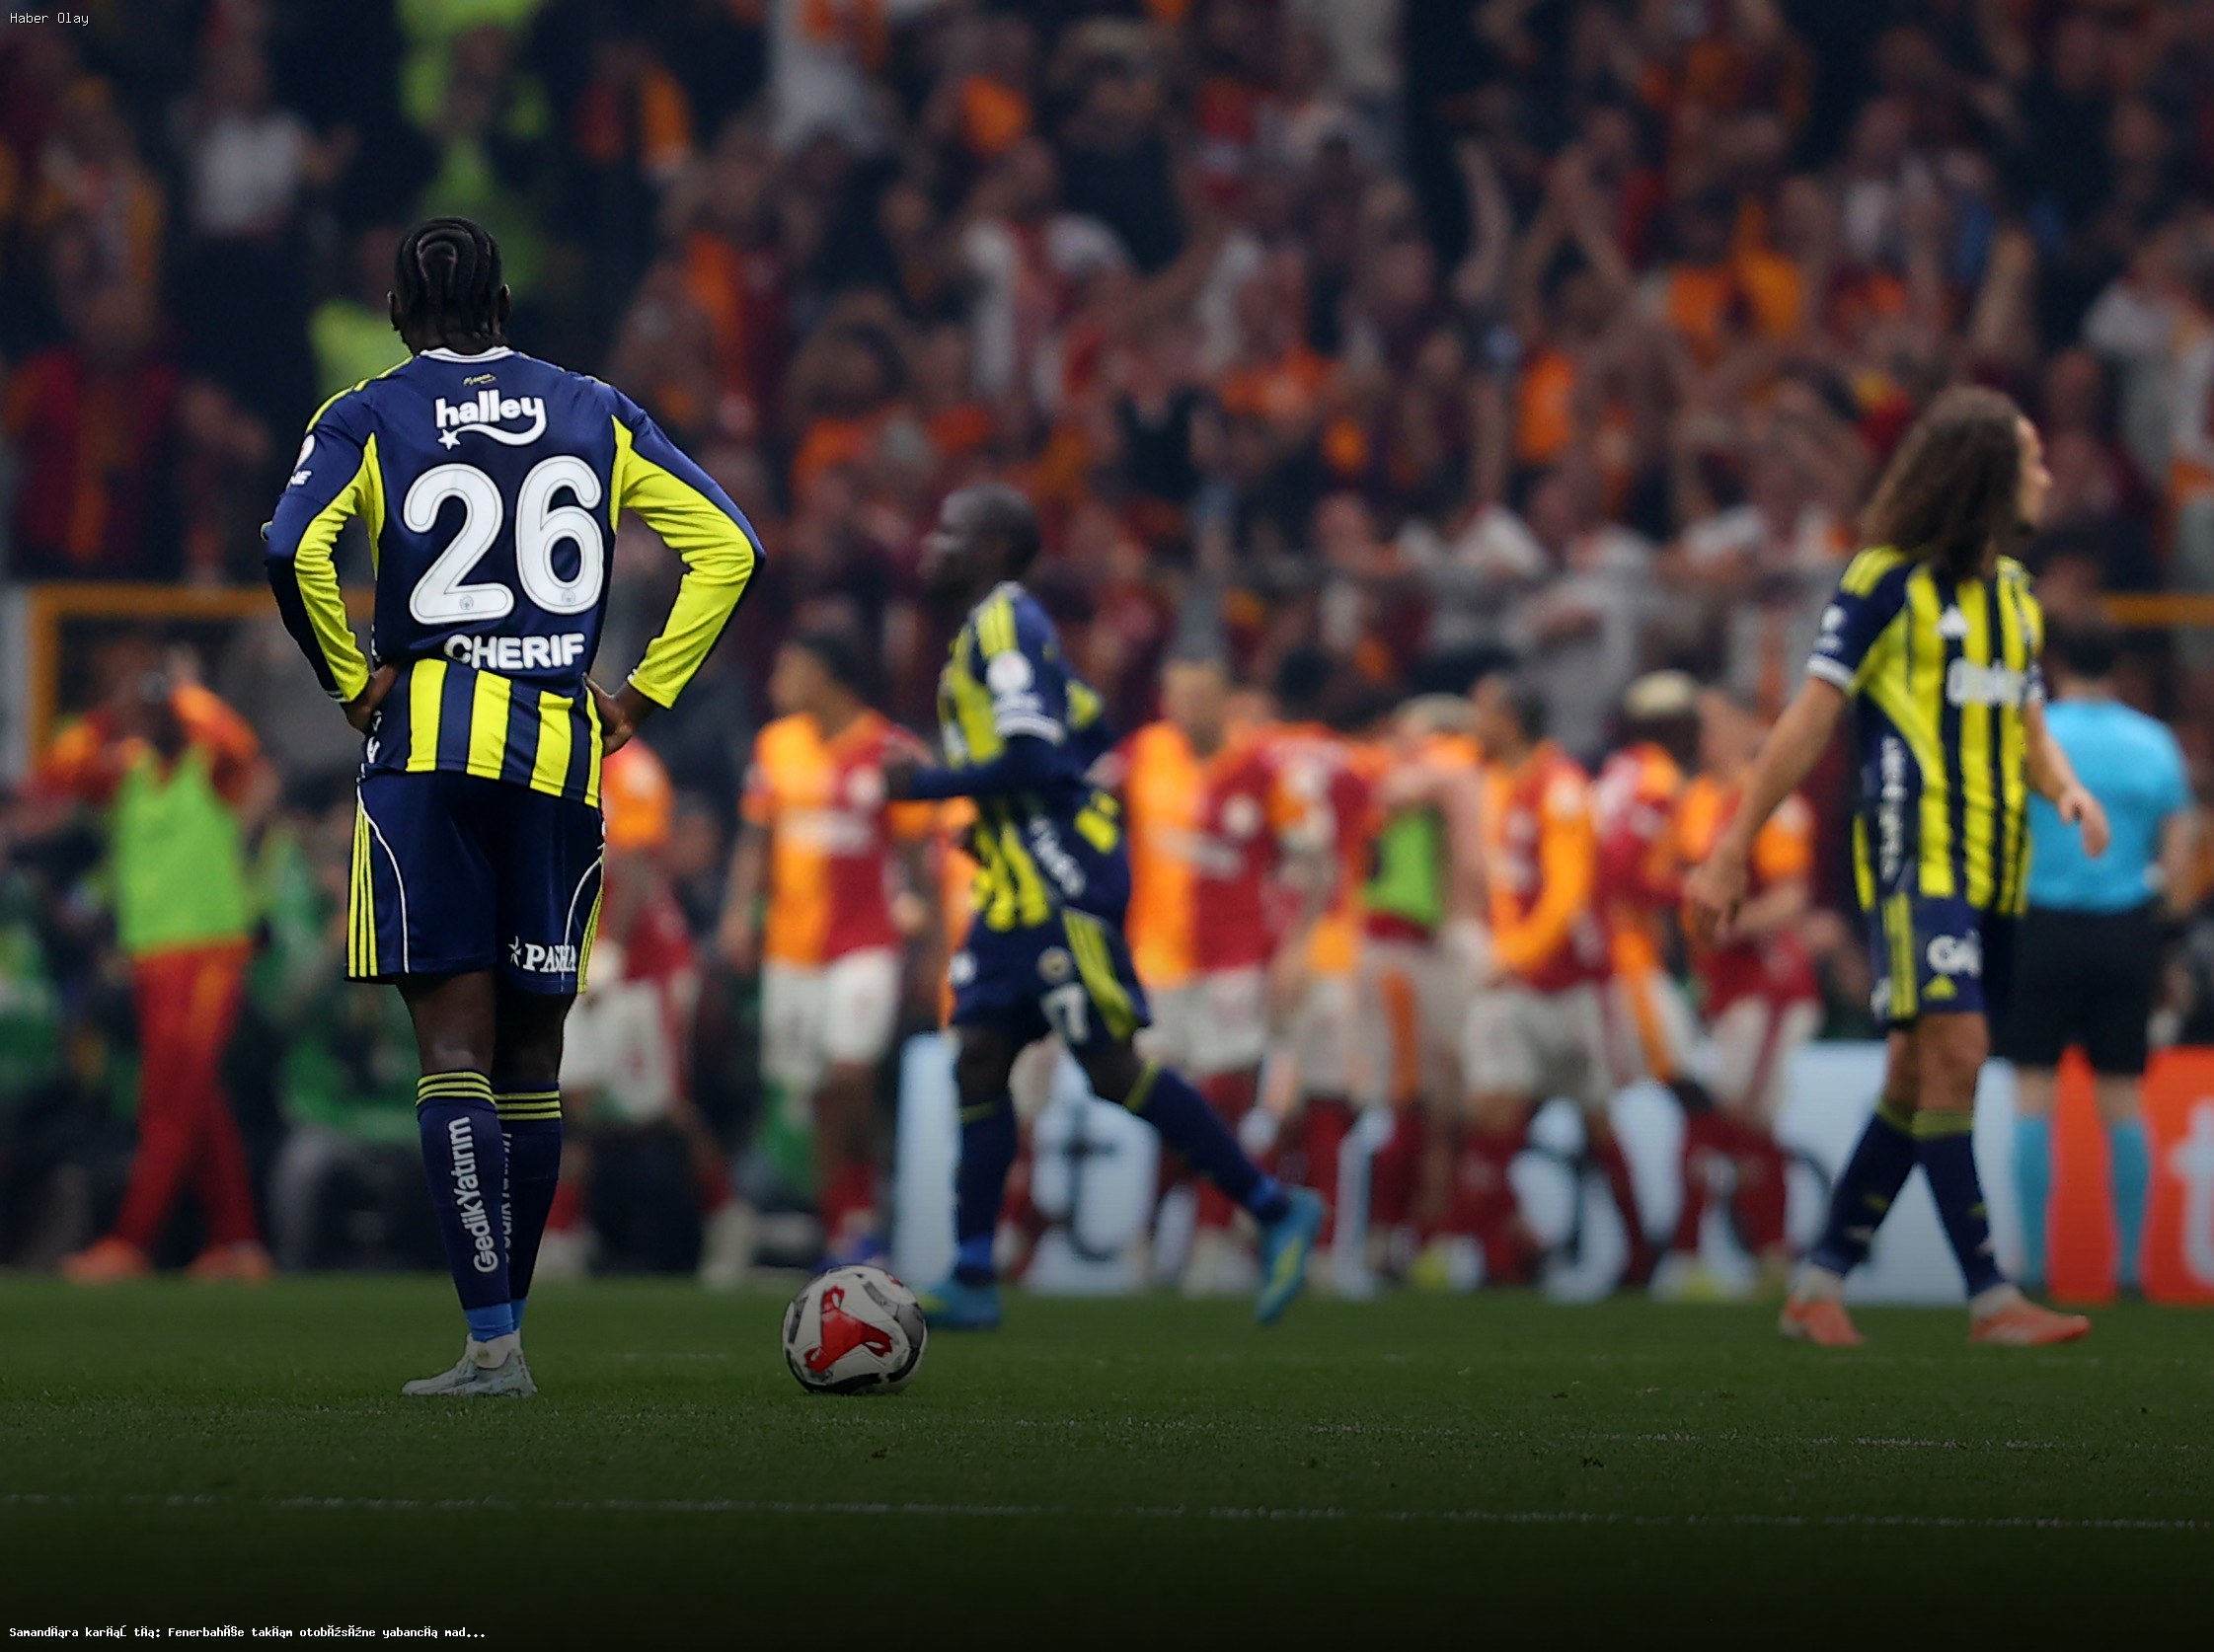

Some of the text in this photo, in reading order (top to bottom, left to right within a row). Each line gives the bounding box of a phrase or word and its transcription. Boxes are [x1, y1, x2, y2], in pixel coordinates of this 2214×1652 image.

[435, 390, 546, 445] halley
[404, 455, 604, 625] 26
[444, 633, 585, 669] CHERIF
